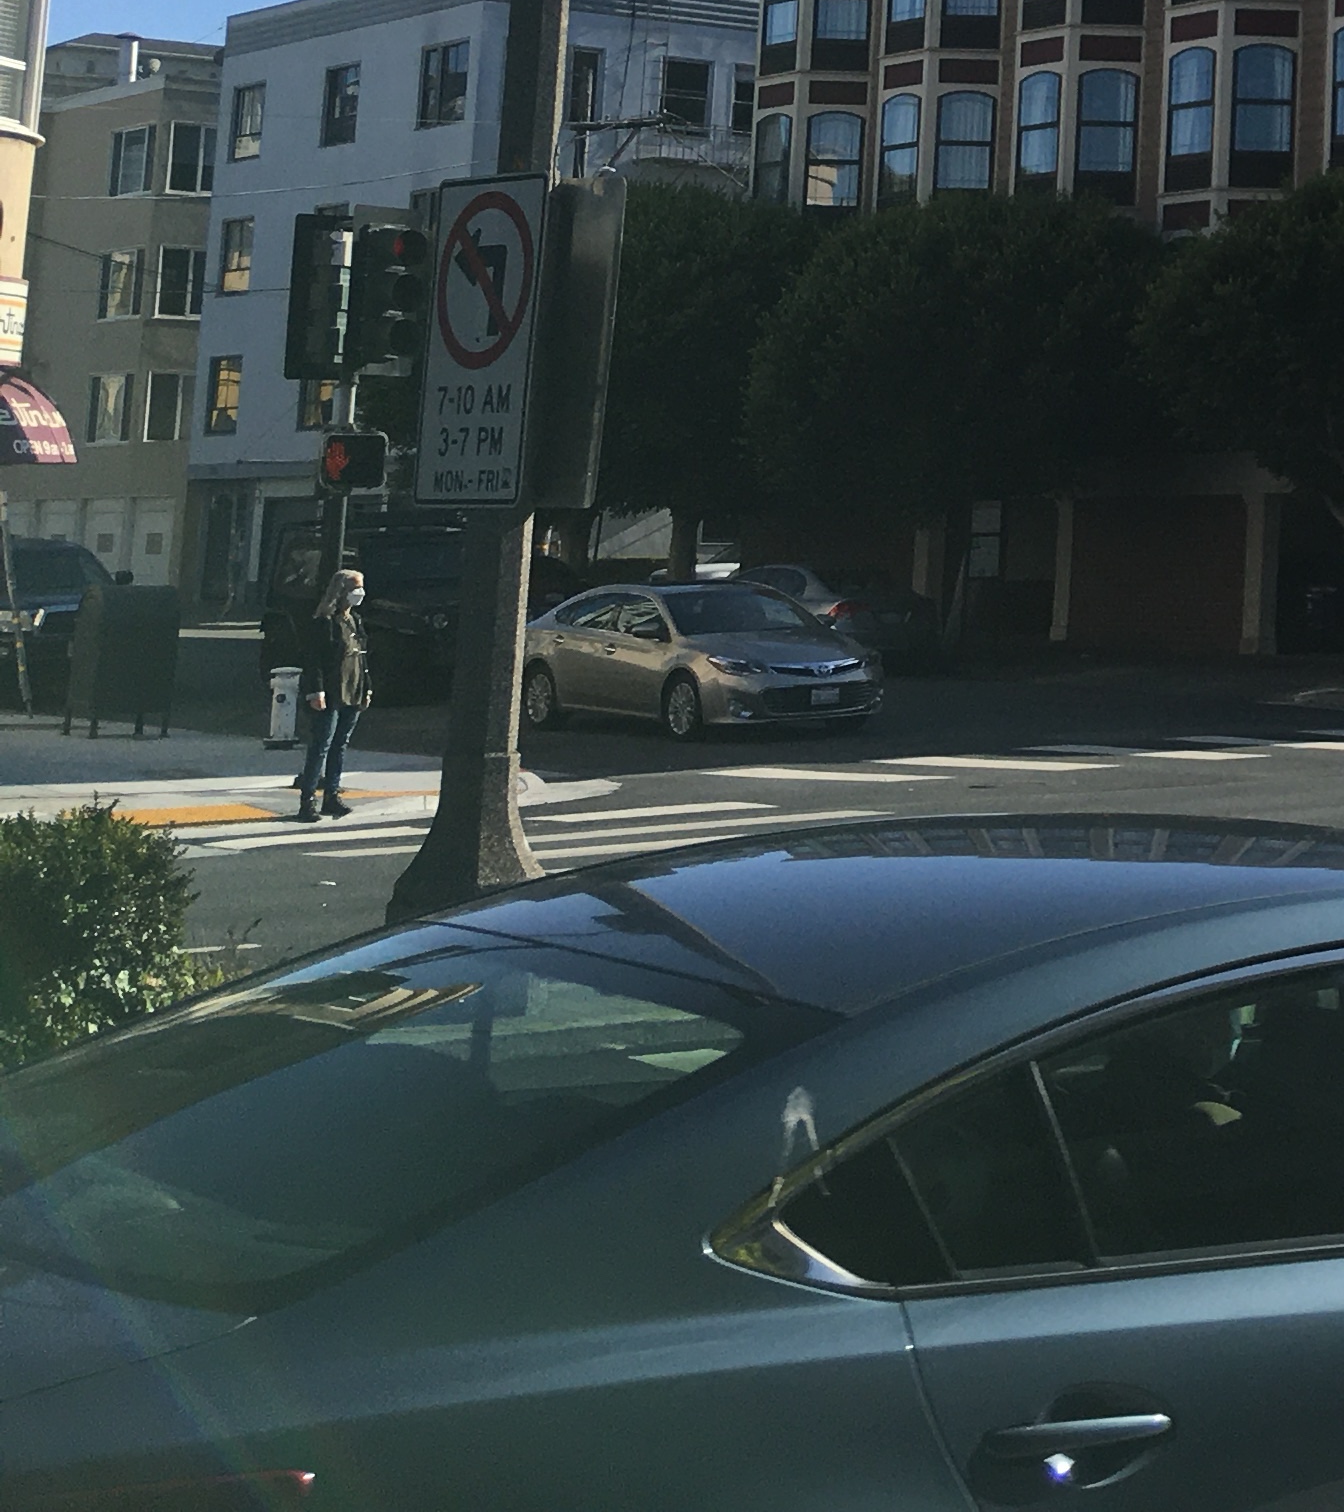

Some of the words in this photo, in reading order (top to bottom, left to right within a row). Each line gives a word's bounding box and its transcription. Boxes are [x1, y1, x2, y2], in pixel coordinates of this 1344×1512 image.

[437, 384, 475, 415] 7-10
[481, 383, 512, 414] AM
[438, 426, 470, 456] 3-7
[476, 426, 503, 456] PM
